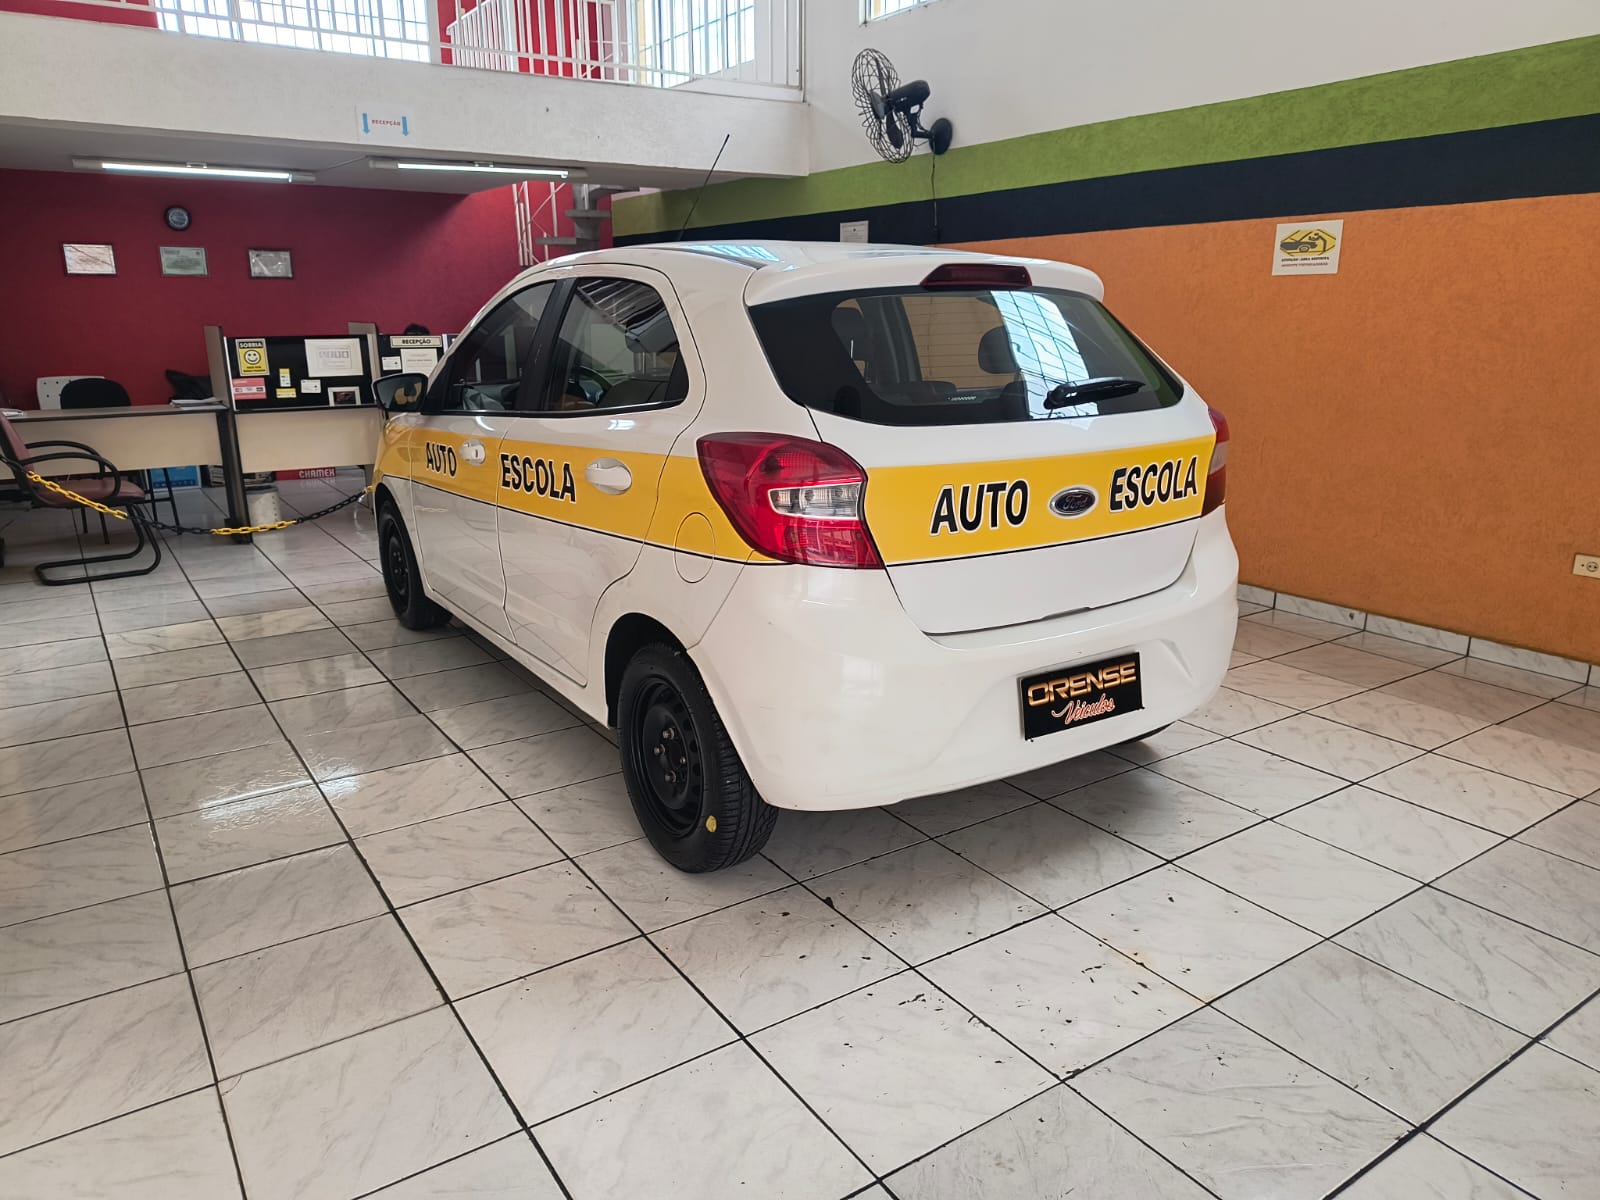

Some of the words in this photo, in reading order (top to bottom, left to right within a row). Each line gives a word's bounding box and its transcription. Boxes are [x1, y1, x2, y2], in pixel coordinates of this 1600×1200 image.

[299, 469, 335, 479] CHAMEX
[425, 442, 457, 477] AUTO
[501, 453, 577, 503] ESCOLA
[930, 479, 1029, 535] AUTO
[1108, 456, 1198, 511] ESCOLA
[1027, 661, 1137, 706] ORENSE
